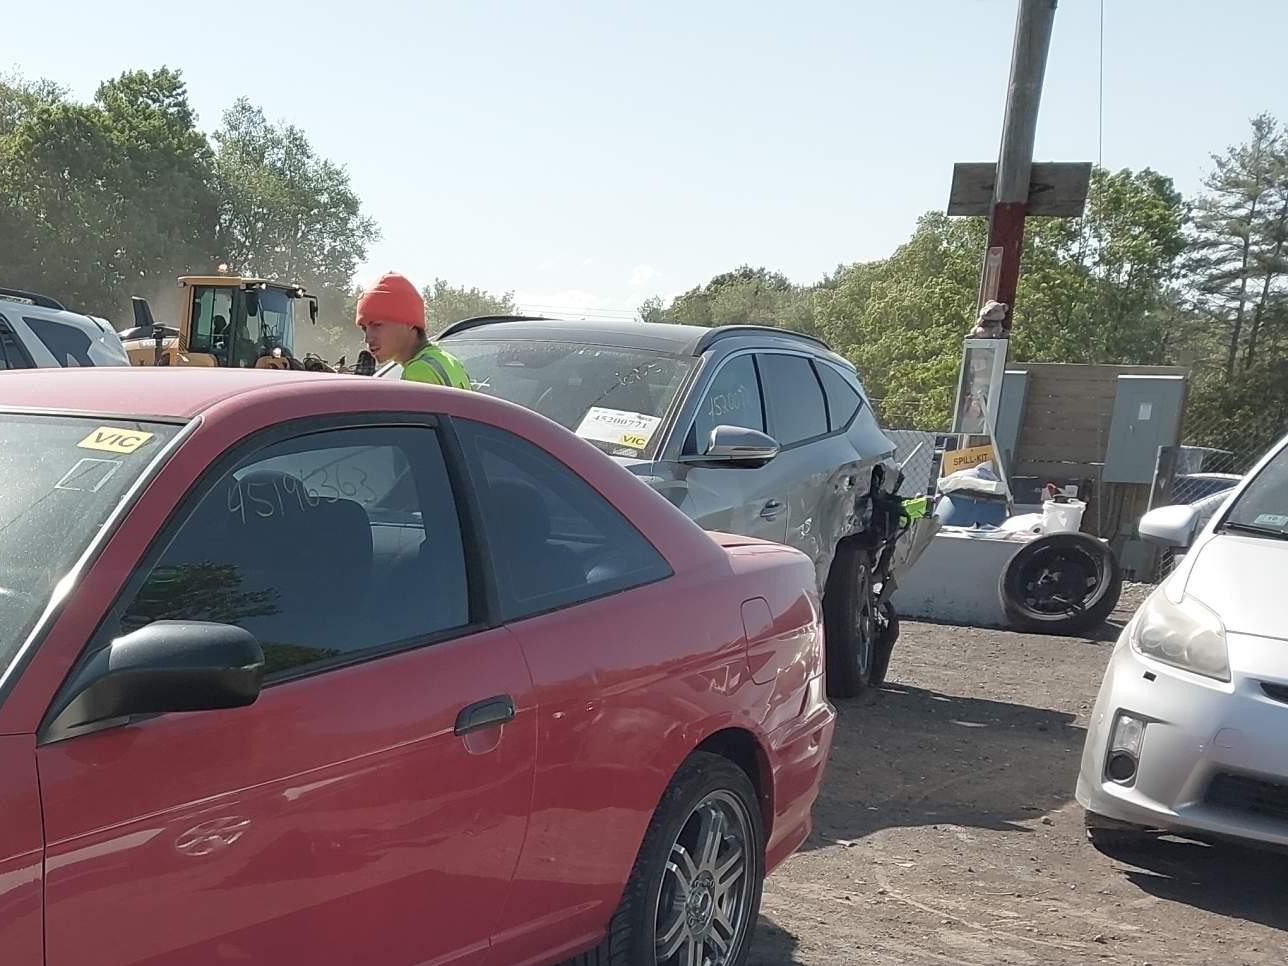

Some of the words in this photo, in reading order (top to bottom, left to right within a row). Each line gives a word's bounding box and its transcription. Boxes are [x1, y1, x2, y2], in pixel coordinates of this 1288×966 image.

[94, 431, 141, 448] VIC
[622, 435, 646, 446] VIC
[227, 463, 378, 525] 45196363
